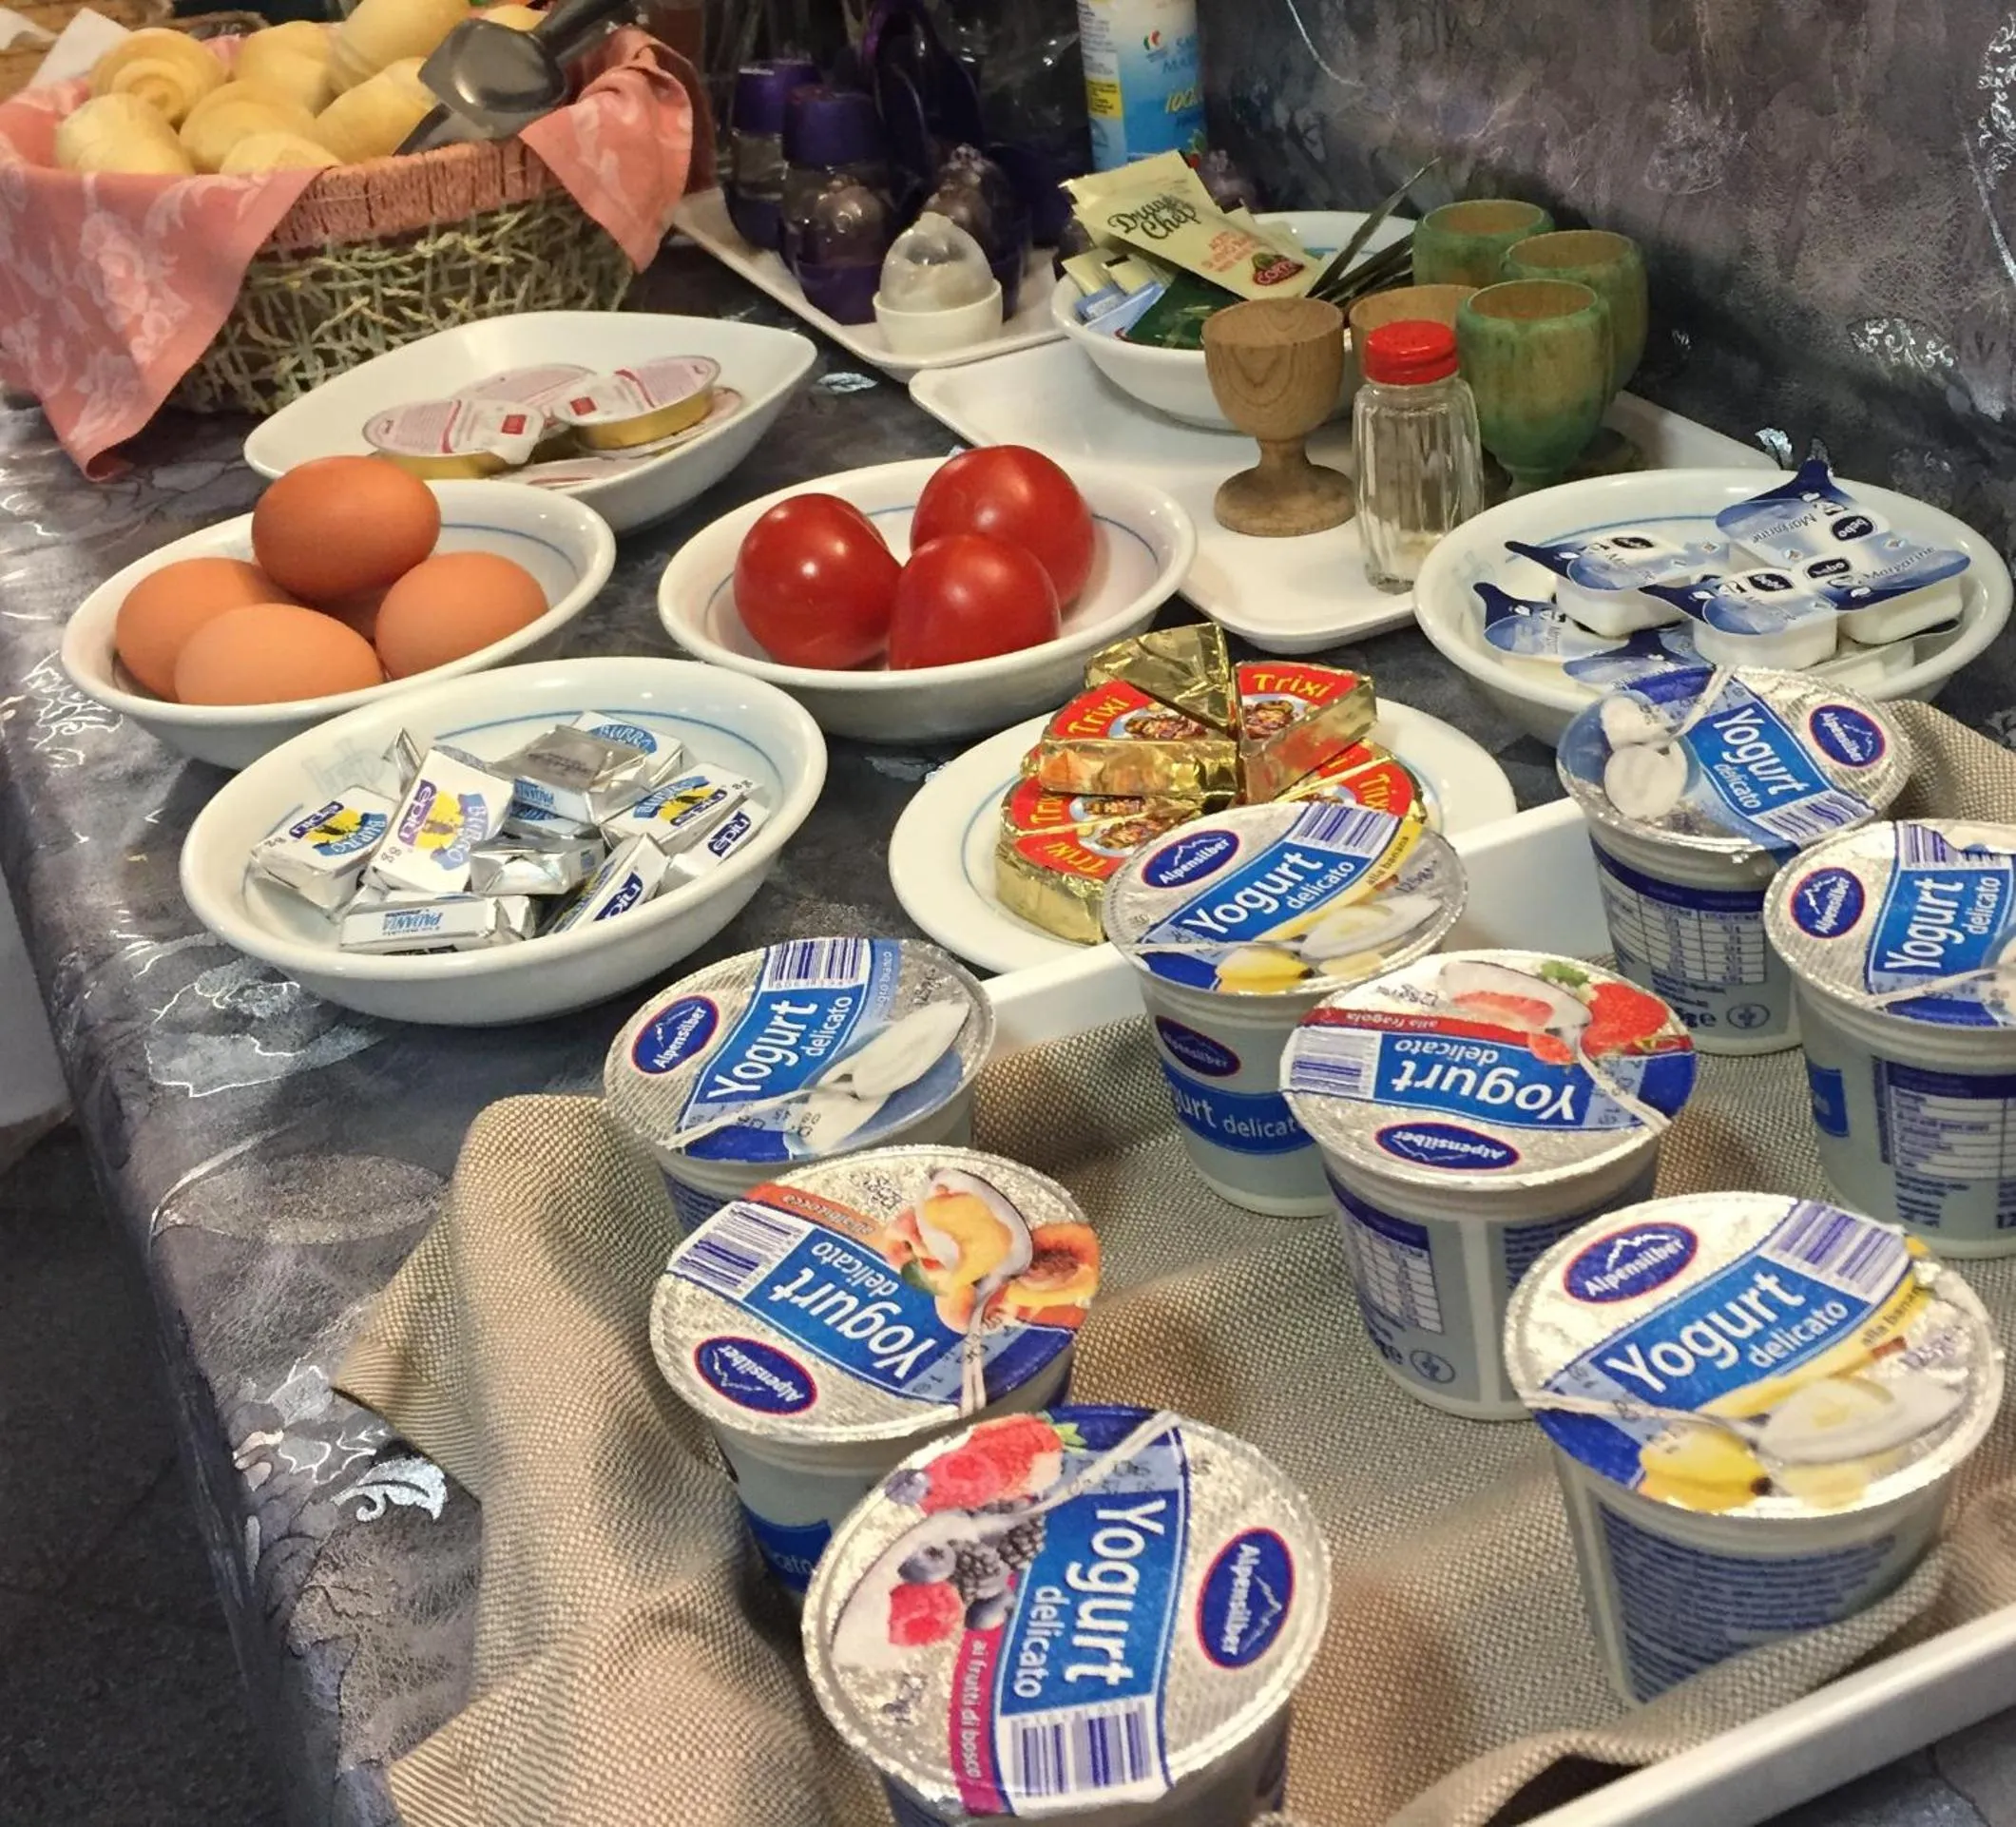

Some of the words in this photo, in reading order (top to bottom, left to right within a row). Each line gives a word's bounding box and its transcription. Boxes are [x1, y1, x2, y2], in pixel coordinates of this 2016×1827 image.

[1253, 674, 1335, 698] Trixi
[1067, 695, 1130, 734] Trixi
[1712, 708, 1810, 795] Yogurt
[1359, 774, 1391, 811] Trix
[1714, 762, 1762, 809] delicato
[332, 816, 387, 854] BURRO
[1044, 841, 1106, 873] Trixi
[1158, 837, 1231, 885] Alpensilber
[1183, 852, 1322, 933] Yogurt
[1287, 861, 1355, 909] delicato
[1962, 876, 2002, 935] delicato
[1884, 877, 1964, 969] Yogurt
[655, 1005, 707, 1070] Alpensilber
[800, 996, 854, 1056] delicato
[1345, 1011, 1406, 1028] fragola
[707, 999, 818, 1098] Yogurt
[1393, 1039, 1499, 1067] delicato
[1392, 1059, 1576, 1122] Yogurt
[1393, 1130, 1507, 1160] Alpensilber
[812, 1240, 899, 1295] delicato
[1584, 1239, 1685, 1297] Alpensilber
[769, 1265, 937, 1379] Yogurt
[1606, 1271, 1805, 1394] Yogurt
[1749, 1301, 1848, 1369] delicato
[717, 1344, 804, 1404] Alpensilber
[1064, 1499, 1167, 1687] Yogurt
[1222, 1543, 1262, 1657] Alpensilber
[971, 1640, 989, 1656] ai
[1013, 1586, 1071, 1699] delicato
[962, 1659, 988, 1706] frutti
[961, 1707, 981, 1726] di
[961, 1728, 982, 1779] bosco
